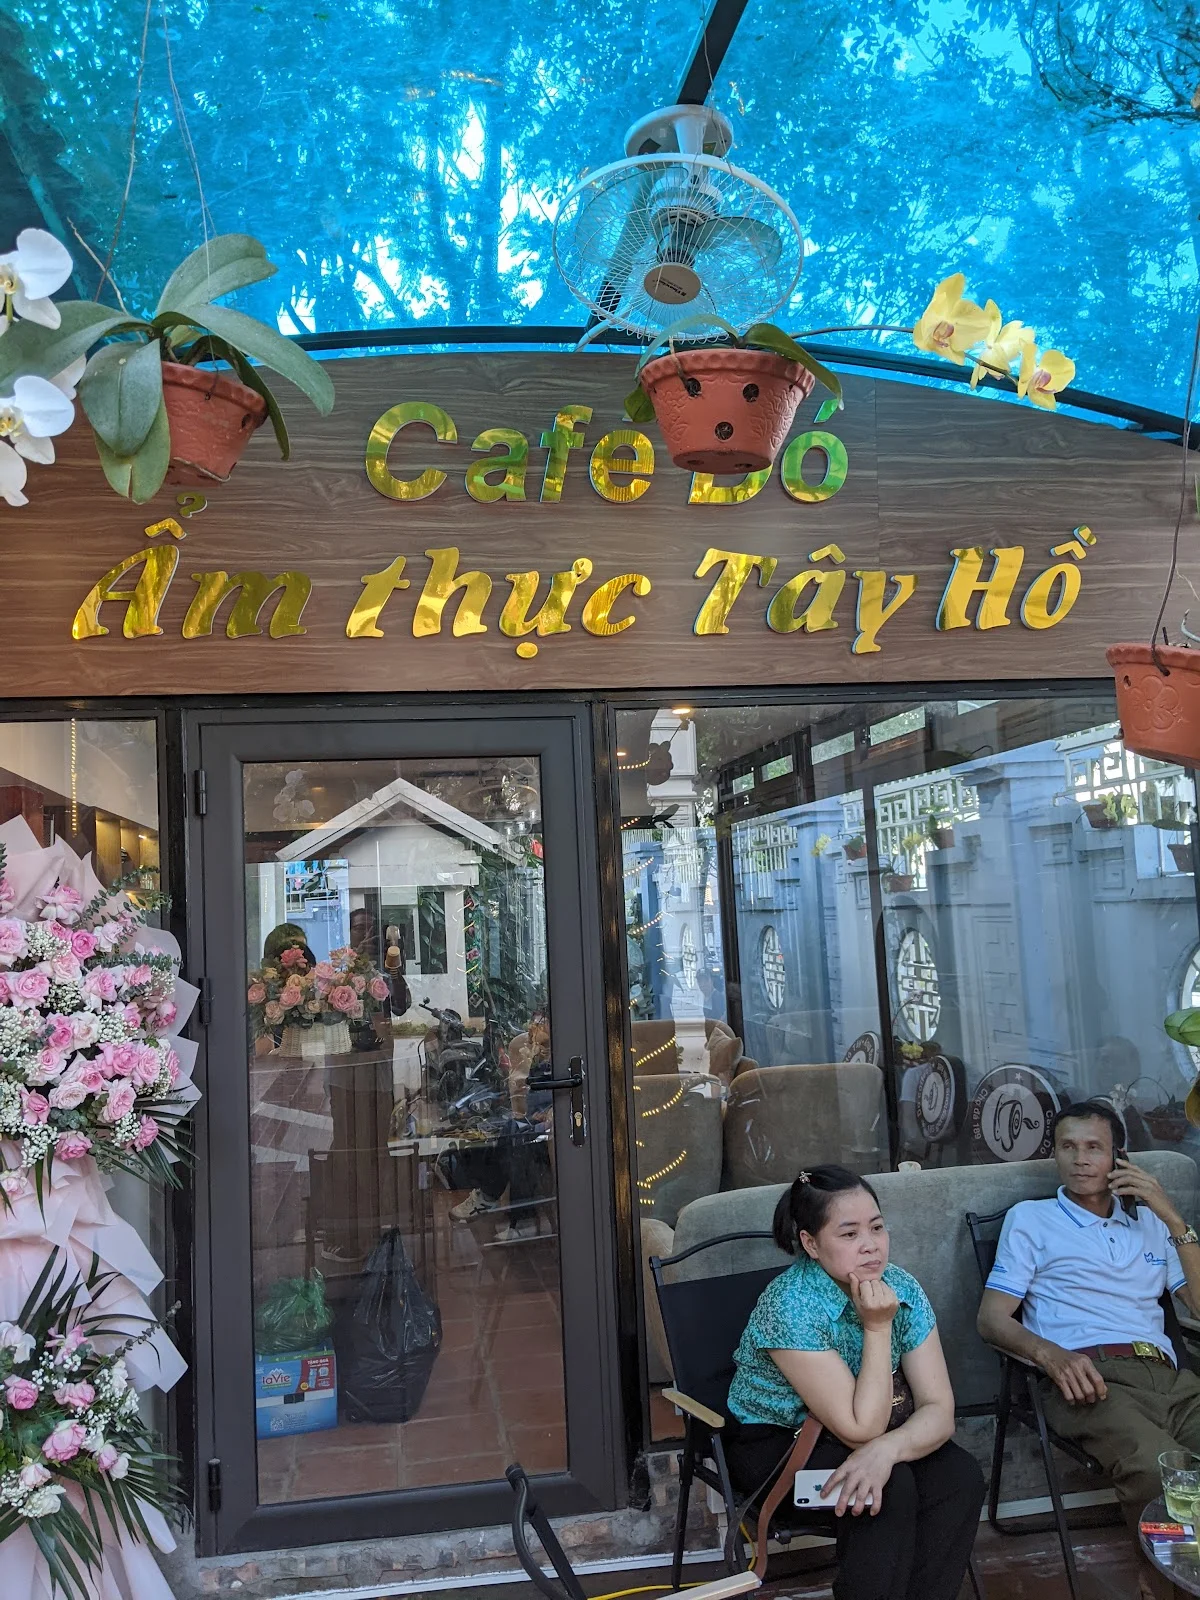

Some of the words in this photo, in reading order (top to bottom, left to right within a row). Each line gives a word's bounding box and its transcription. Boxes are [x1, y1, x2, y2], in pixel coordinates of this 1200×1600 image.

[71, 492, 313, 640] Ẩm
[345, 546, 652, 660] thực
[693, 543, 918, 655] Tây
[935, 525, 1097, 631] Hồ
